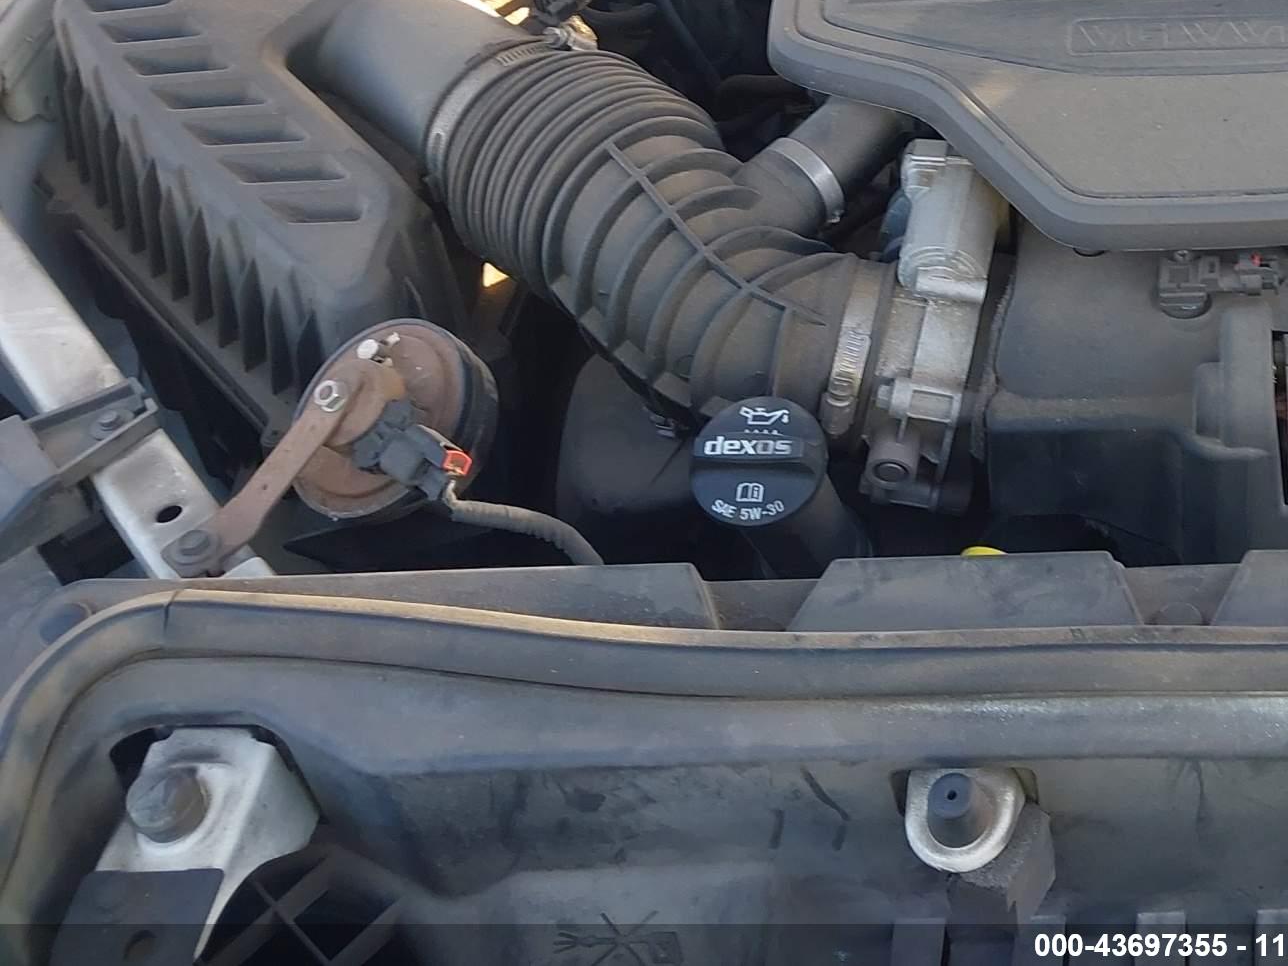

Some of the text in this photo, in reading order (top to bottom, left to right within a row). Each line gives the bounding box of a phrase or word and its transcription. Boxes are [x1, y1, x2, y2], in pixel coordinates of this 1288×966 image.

[703, 435, 793, 455] dexos
[711, 499, 785, 521] SAE 5W-30
